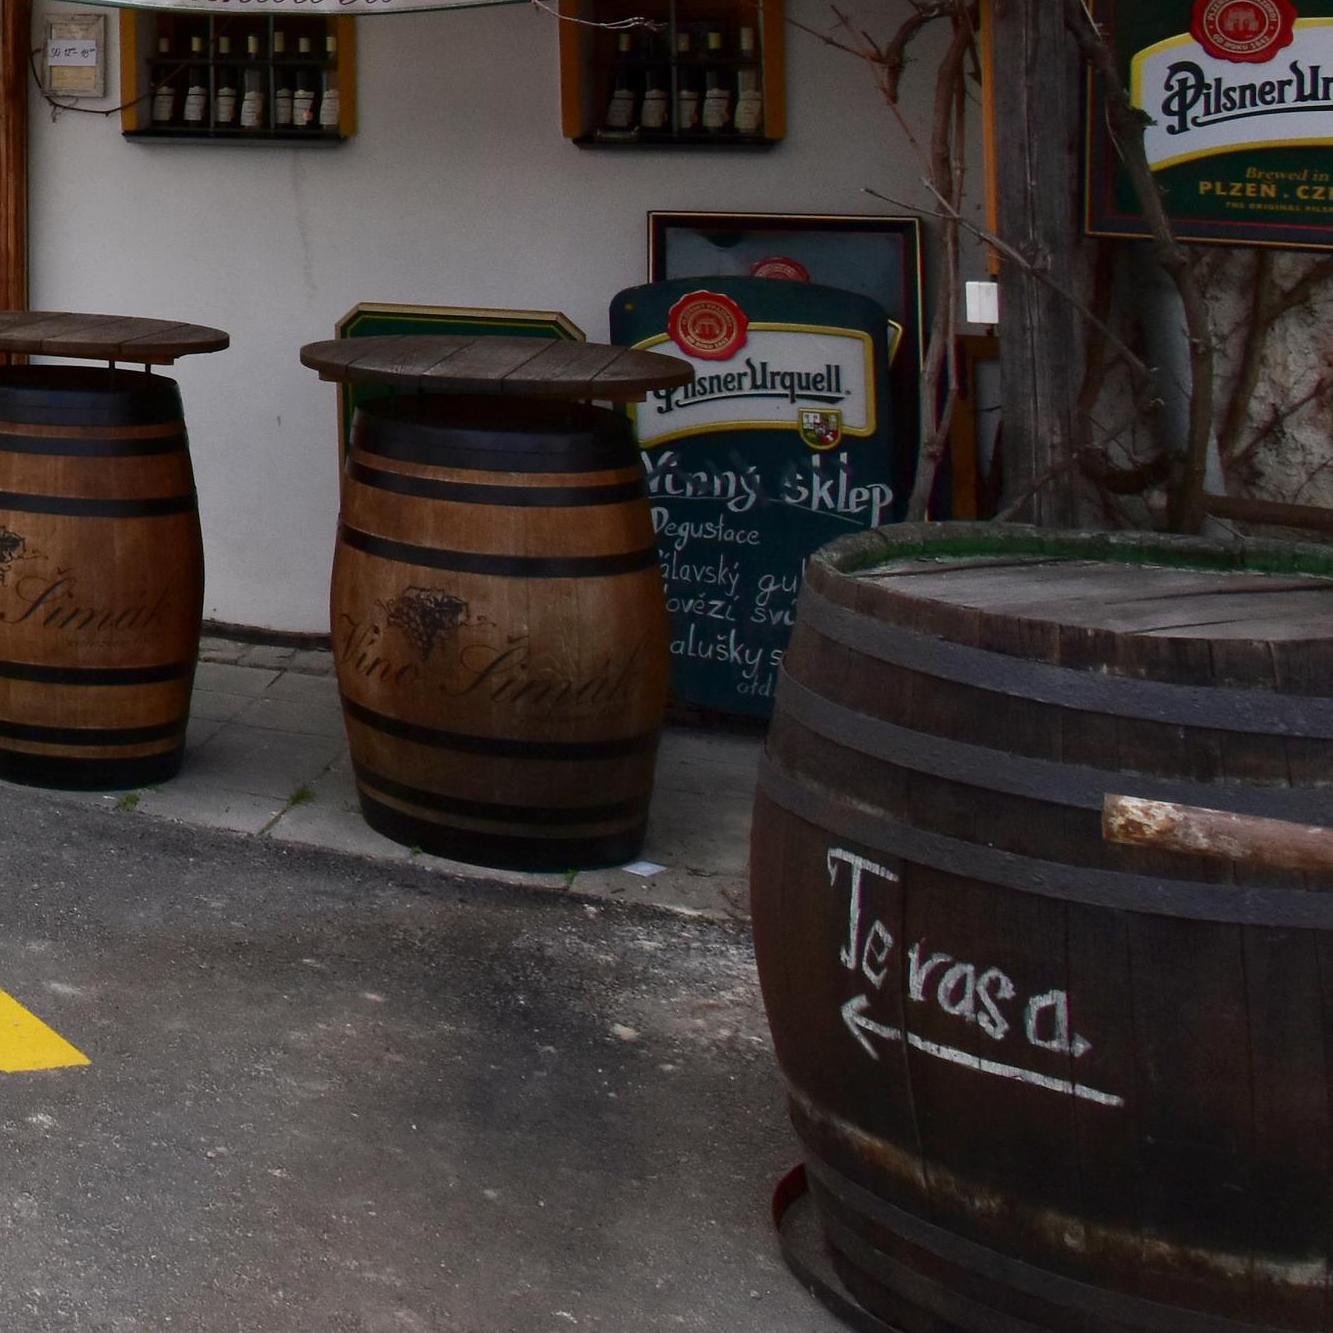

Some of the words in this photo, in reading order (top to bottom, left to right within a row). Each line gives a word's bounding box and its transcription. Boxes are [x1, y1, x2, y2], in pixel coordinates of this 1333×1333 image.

[1161, 60, 1292, 135] Pilsner
[1198, 179, 1278, 198] PLZEŇ
[1246, 167, 1310, 181] Brewed
[1313, 170, 1329, 181] in
[745, 357, 843, 404] Urquell
[784, 452, 894, 528] sklep
[649, 506, 761, 551] Degustace
[658, 549, 740, 597] álavský
[663, 583, 737, 621] ovězí
[669, 622, 763, 679] alušky
[826, 847, 1093, 1058] Terasa
